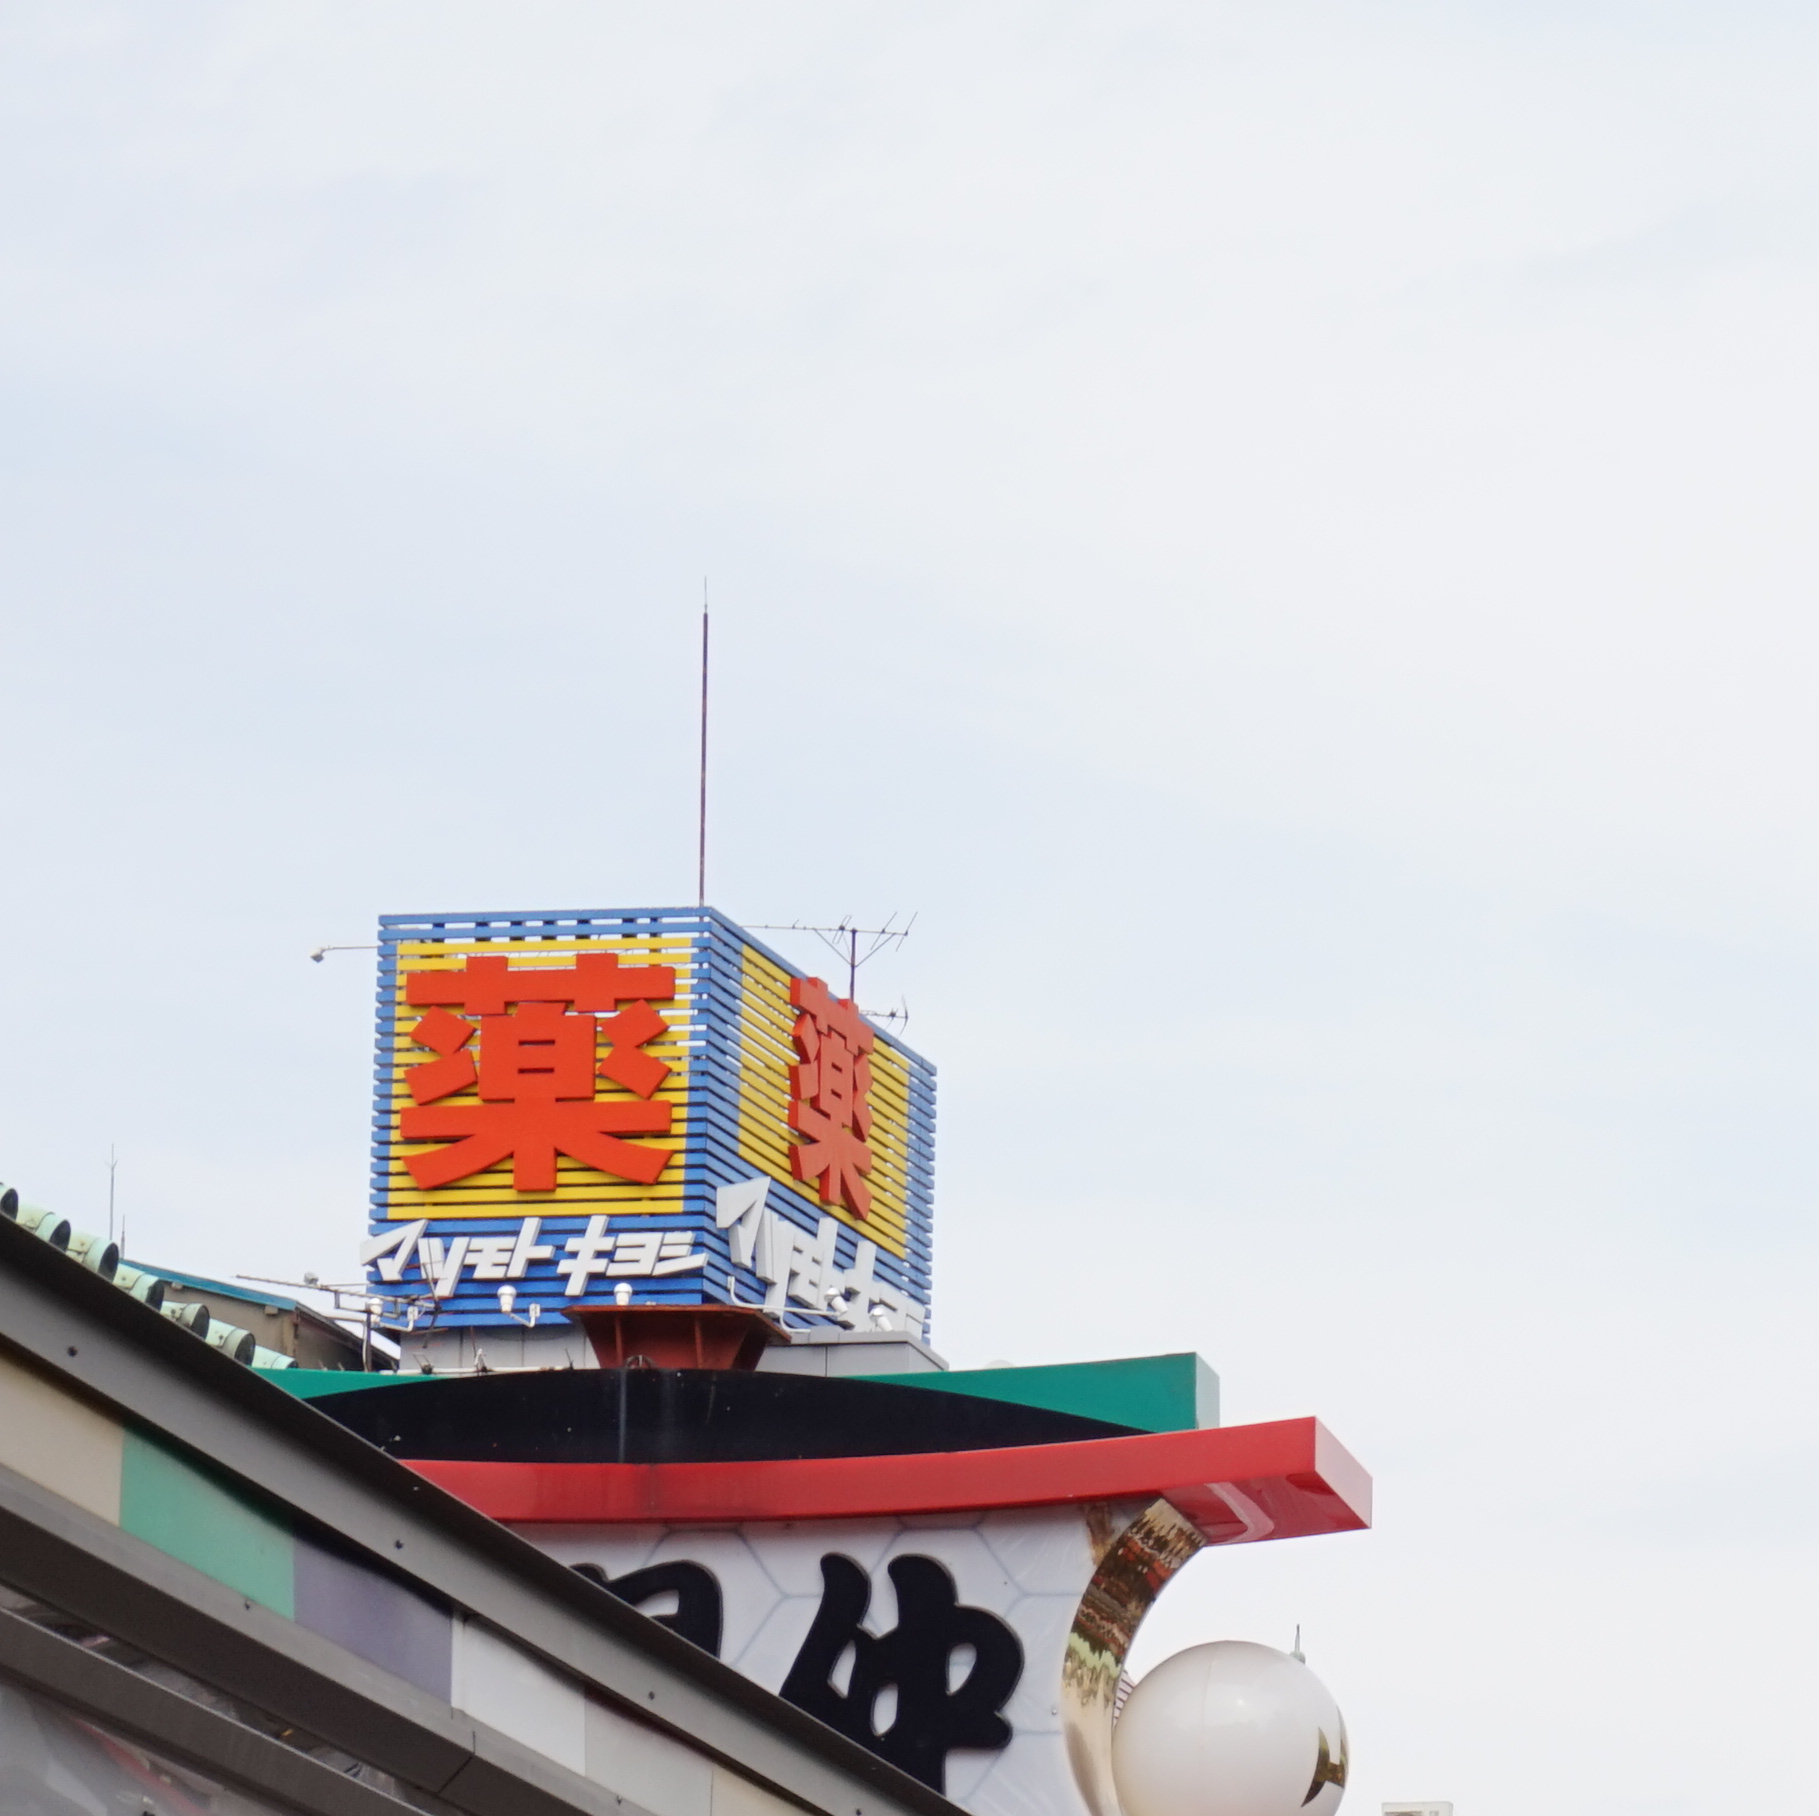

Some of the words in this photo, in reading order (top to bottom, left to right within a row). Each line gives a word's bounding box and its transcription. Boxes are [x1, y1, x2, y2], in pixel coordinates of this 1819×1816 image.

[399, 951, 677, 1193] 薬
[788, 977, 875, 1222] 薬
[360, 1214, 709, 1297] マツモトキヨシ
